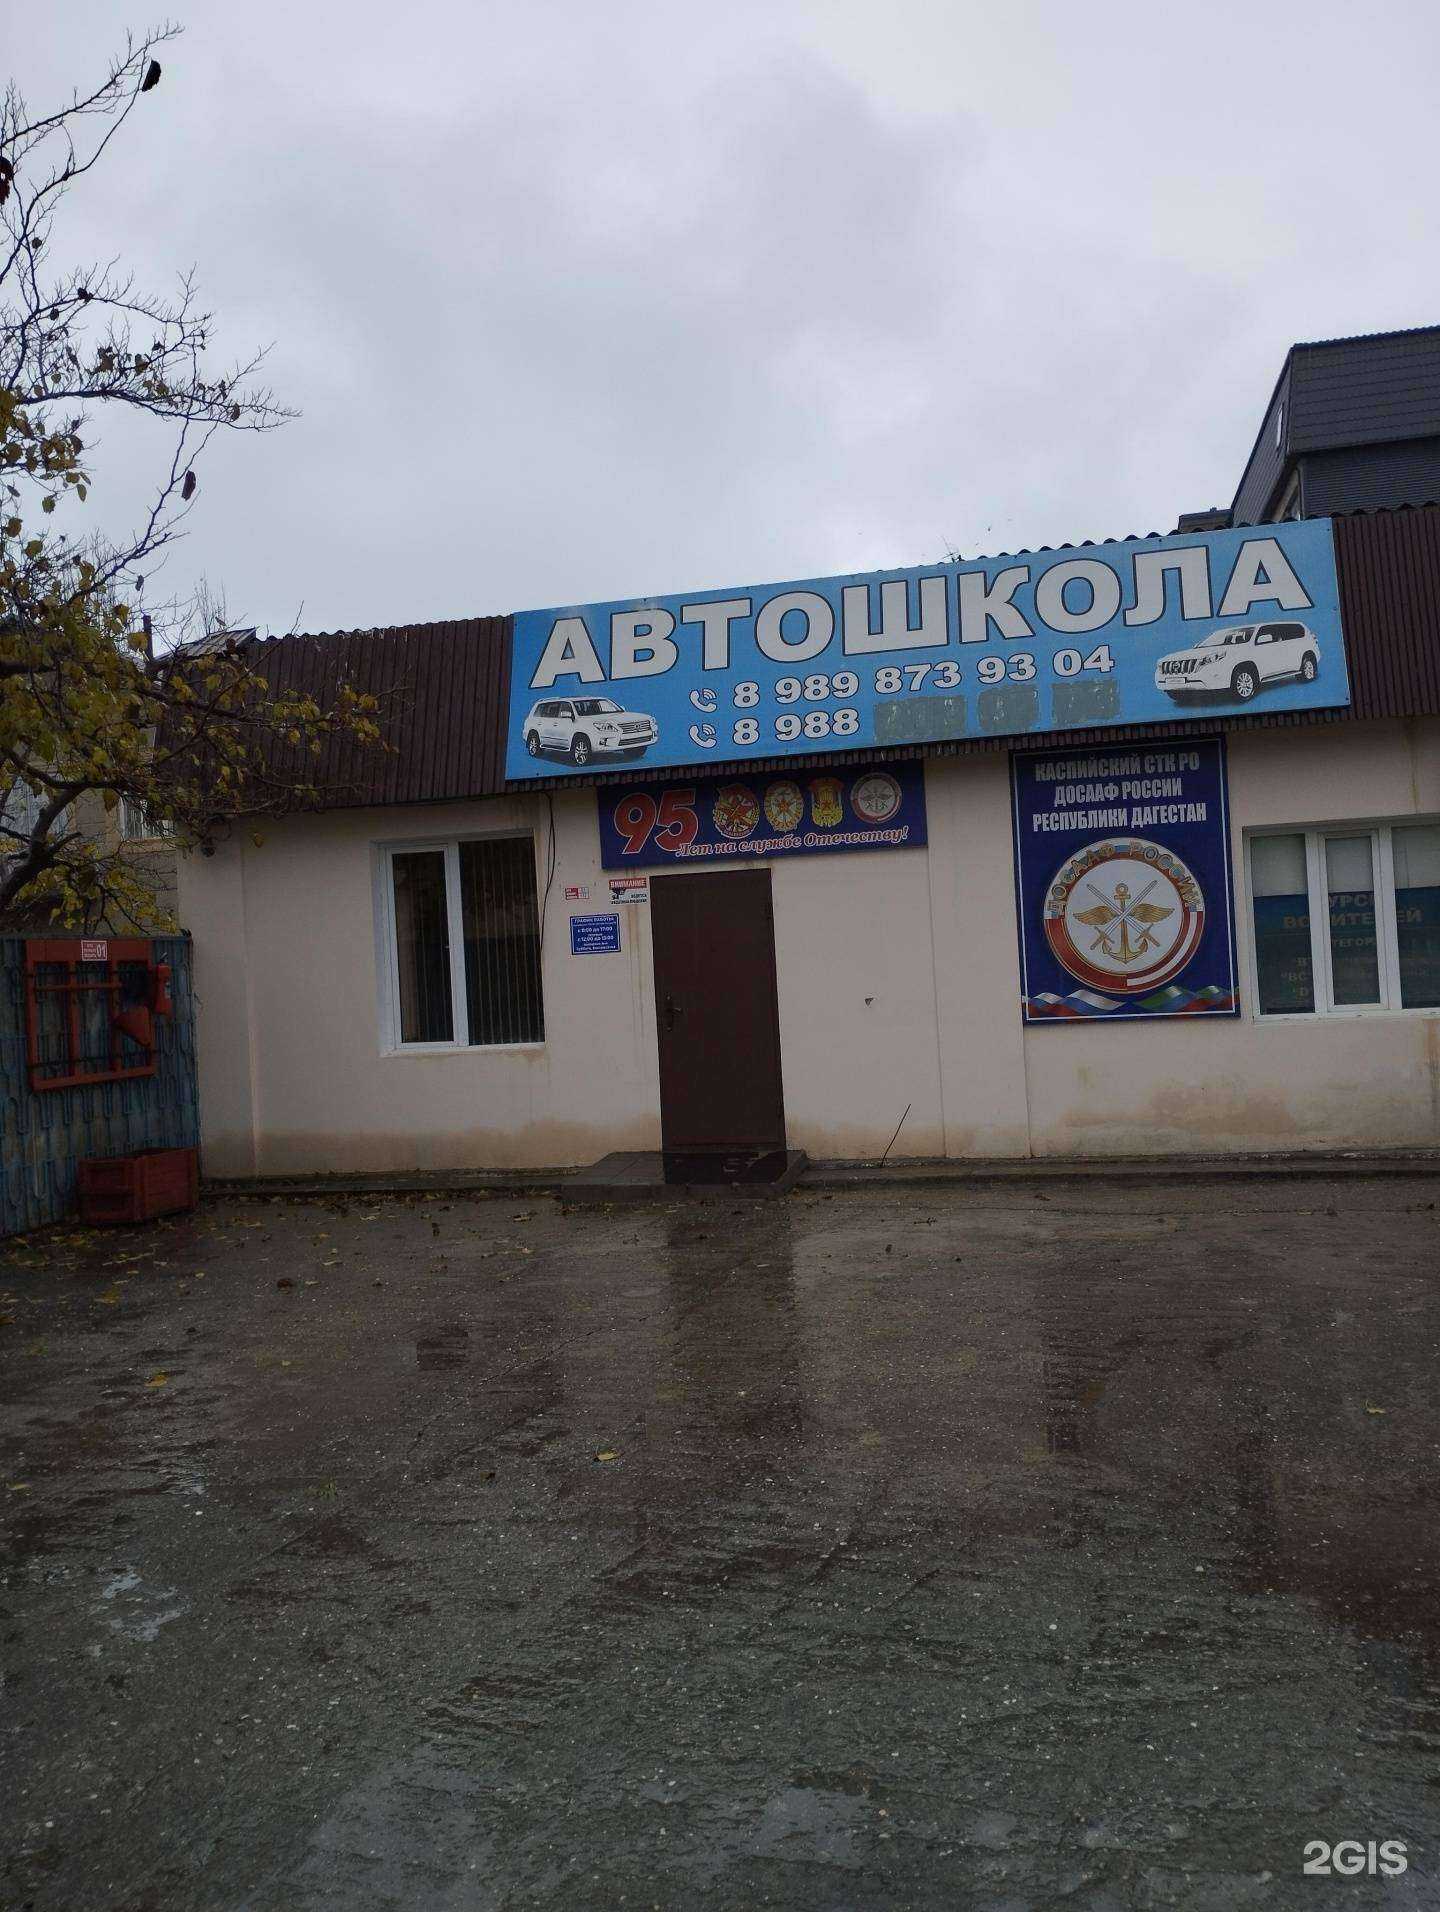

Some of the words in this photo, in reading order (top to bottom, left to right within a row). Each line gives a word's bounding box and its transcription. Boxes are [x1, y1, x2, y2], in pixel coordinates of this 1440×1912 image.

[528, 537, 1313, 689] АВТОШКОЛА
[733, 681, 760, 708] 8
[774, 671, 859, 704] 989
[875, 661, 962, 694] 873
[977, 653, 1037, 684] 93
[1053, 645, 1115, 677] 04
[733, 718, 760, 745] 8
[774, 708, 860, 741] 988
[1035, 753, 1141, 781] КАСПИЙСКИЙ
[1144, 755, 1176, 774] СТК
[1179, 752, 1200, 772] РО
[1054, 782, 1119, 807] ДОСААФ
[1122, 777, 1182, 800] РОССИИ
[613, 788, 699, 855] 95
[1032, 807, 1128, 832] РЕСПУБЛИКИ
[1131, 802, 1207, 828] ДАГЕСТАН
[715, 839, 737, 854] на
[738, 834, 802, 854] службе
[804, 825, 908, 847] Отечеству!
